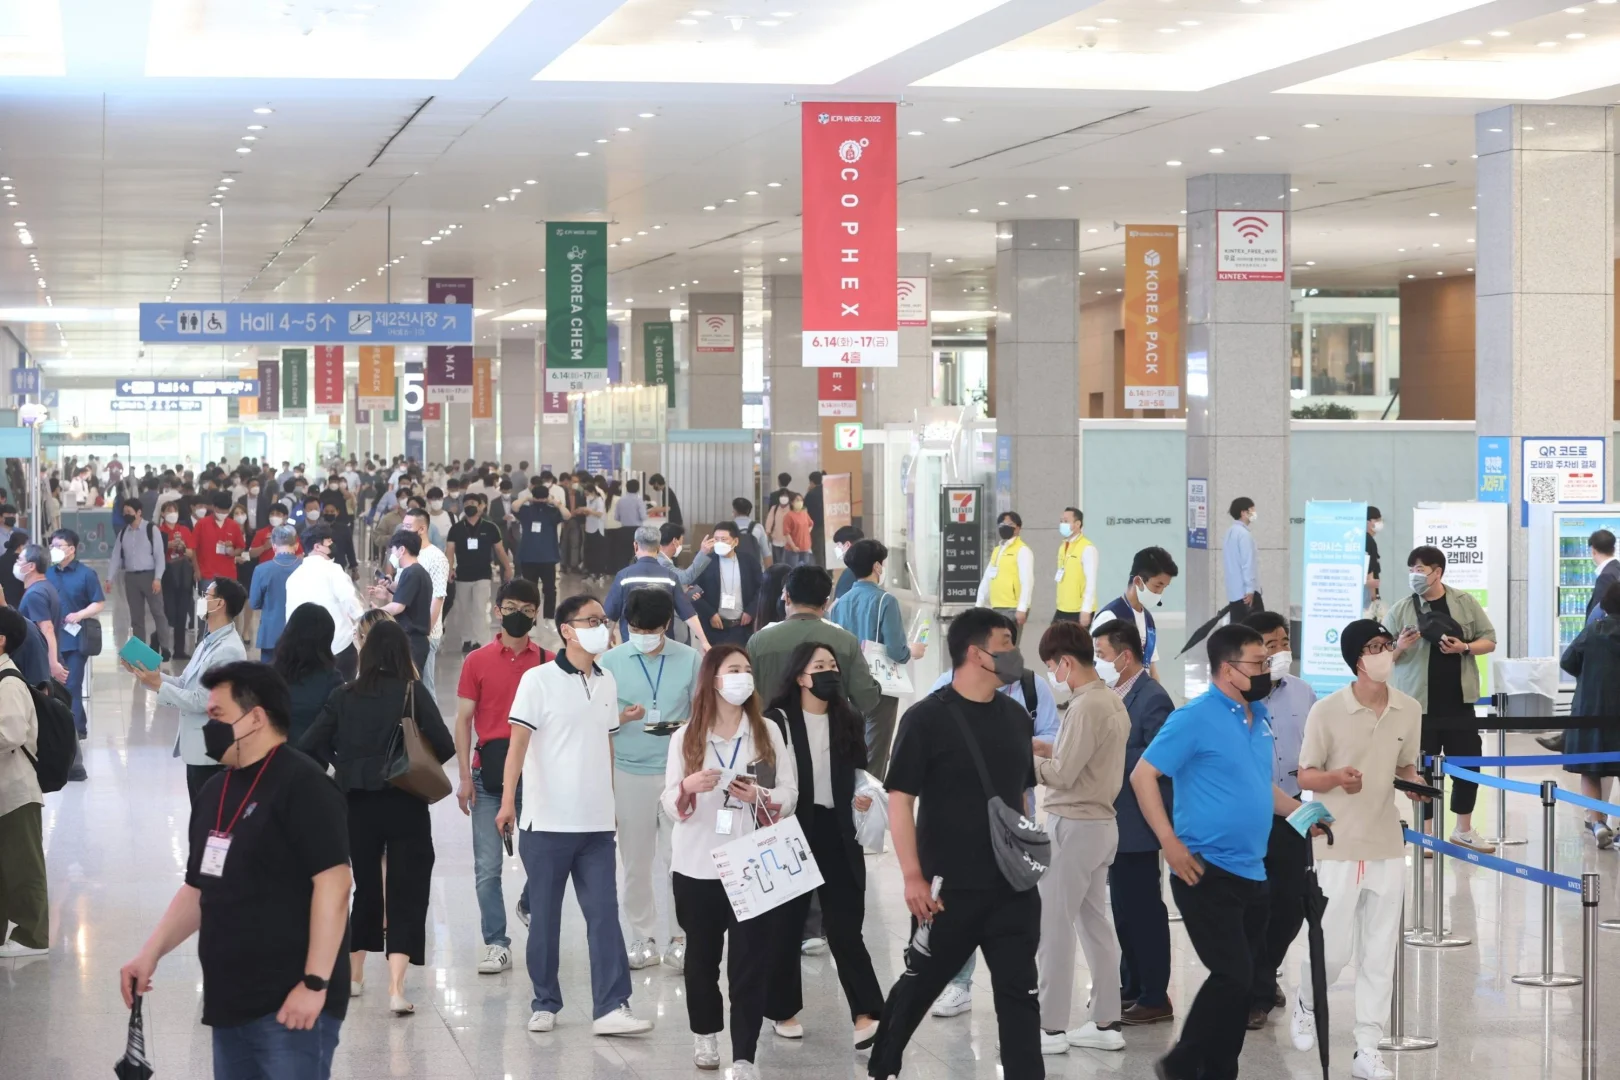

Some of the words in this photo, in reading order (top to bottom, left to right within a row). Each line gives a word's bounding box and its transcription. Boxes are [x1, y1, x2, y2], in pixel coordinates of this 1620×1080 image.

[841, 168, 858, 316] COPHEX
[570, 264, 582, 314] KOREA
[1146, 270, 1158, 325] KOREA
[240, 312, 274, 332] Hall
[375, 312, 438, 326] 제2전시장
[570, 318, 583, 360] CHEM
[1146, 332, 1158, 374] PACK
[446, 354, 454, 380] MAT
[403, 373, 424, 412] 5
[1540, 446, 1556, 456] QR
[1559, 446, 1588, 456] 코드로
[1530, 460, 1554, 468] 모바일
[1556, 460, 1579, 469] 주차비
[1581, 460, 1597, 468] 결제
[1441, 536, 1478, 548] 생수병
[1447, 551, 1483, 564] 캠페인
